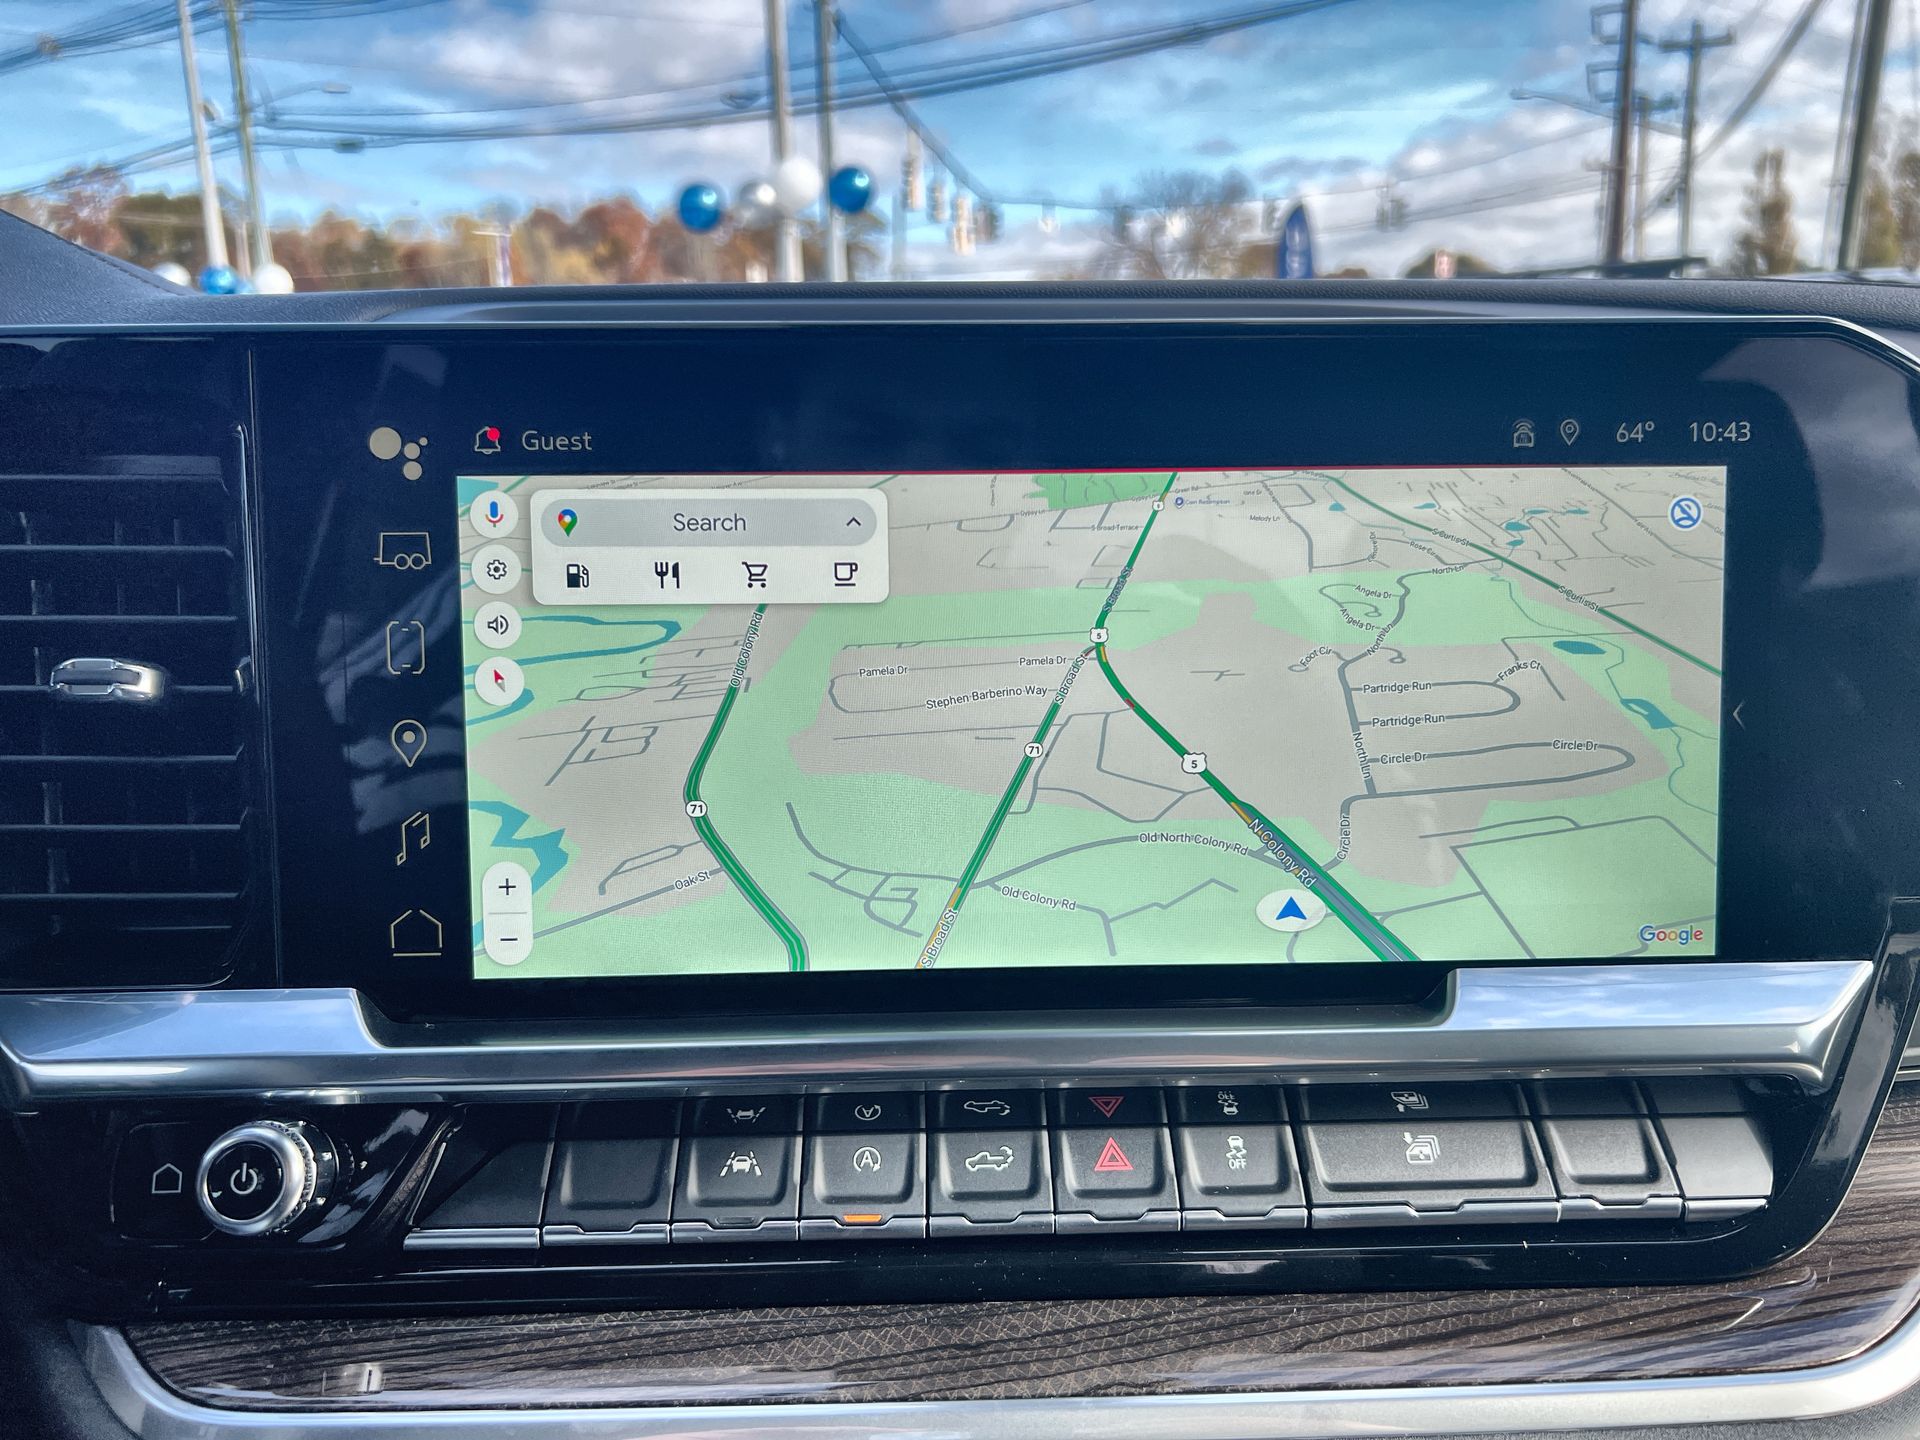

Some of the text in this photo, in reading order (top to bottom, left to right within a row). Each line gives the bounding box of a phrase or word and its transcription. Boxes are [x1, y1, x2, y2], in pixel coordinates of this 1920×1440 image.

[521, 429, 593, 451] Guest
[1689, 421, 1751, 443] 10:43
[673, 513, 747, 532] Search
[1432, 567, 1453, 575] North
[1106, 578, 1127, 605] Broad
[1355, 584, 1392, 599] Angela Dr
[1558, 585, 1600, 612] S Curtis St
[1340, 607, 1375, 631] Angela Dr
[730, 612, 763, 686] Old Colony Rd
[1367, 622, 1394, 656] North Ln
[1019, 656, 1067, 666] Pamela Dr
[1299, 646, 1333, 667] Foot Cir
[859, 665, 908, 678] Pamela Dr
[1055, 655, 1087, 705] S Broad St
[1498, 659, 1541, 681] Franks Ct
[926, 685, 1048, 710] Stephen Barberino Way
[1363, 681, 1432, 694] Partridge Run
[1372, 714, 1445, 728] Partridge Run
[1028, 745, 1040, 755] 71
[1353, 732, 1371, 779] North Ln
[1553, 739, 1598, 751] Circle Dr
[1191, 760, 1198, 769] 5
[1380, 752, 1427, 764] Circle Dr
[690, 804, 703, 814] 71
[1139, 832, 1249, 856] Old North Colony Rd
[1337, 814, 1351, 860] Circle Dr
[1249, 818, 1317, 888] N Colony Rd
[674, 870, 711, 890] Oak St
[1001, 885, 1077, 911] Old Colony Rd
[921, 908, 958, 967] S Broad St
[1640, 924, 1704, 946] Google
[1228, 1159, 1247, 1170] OFF
